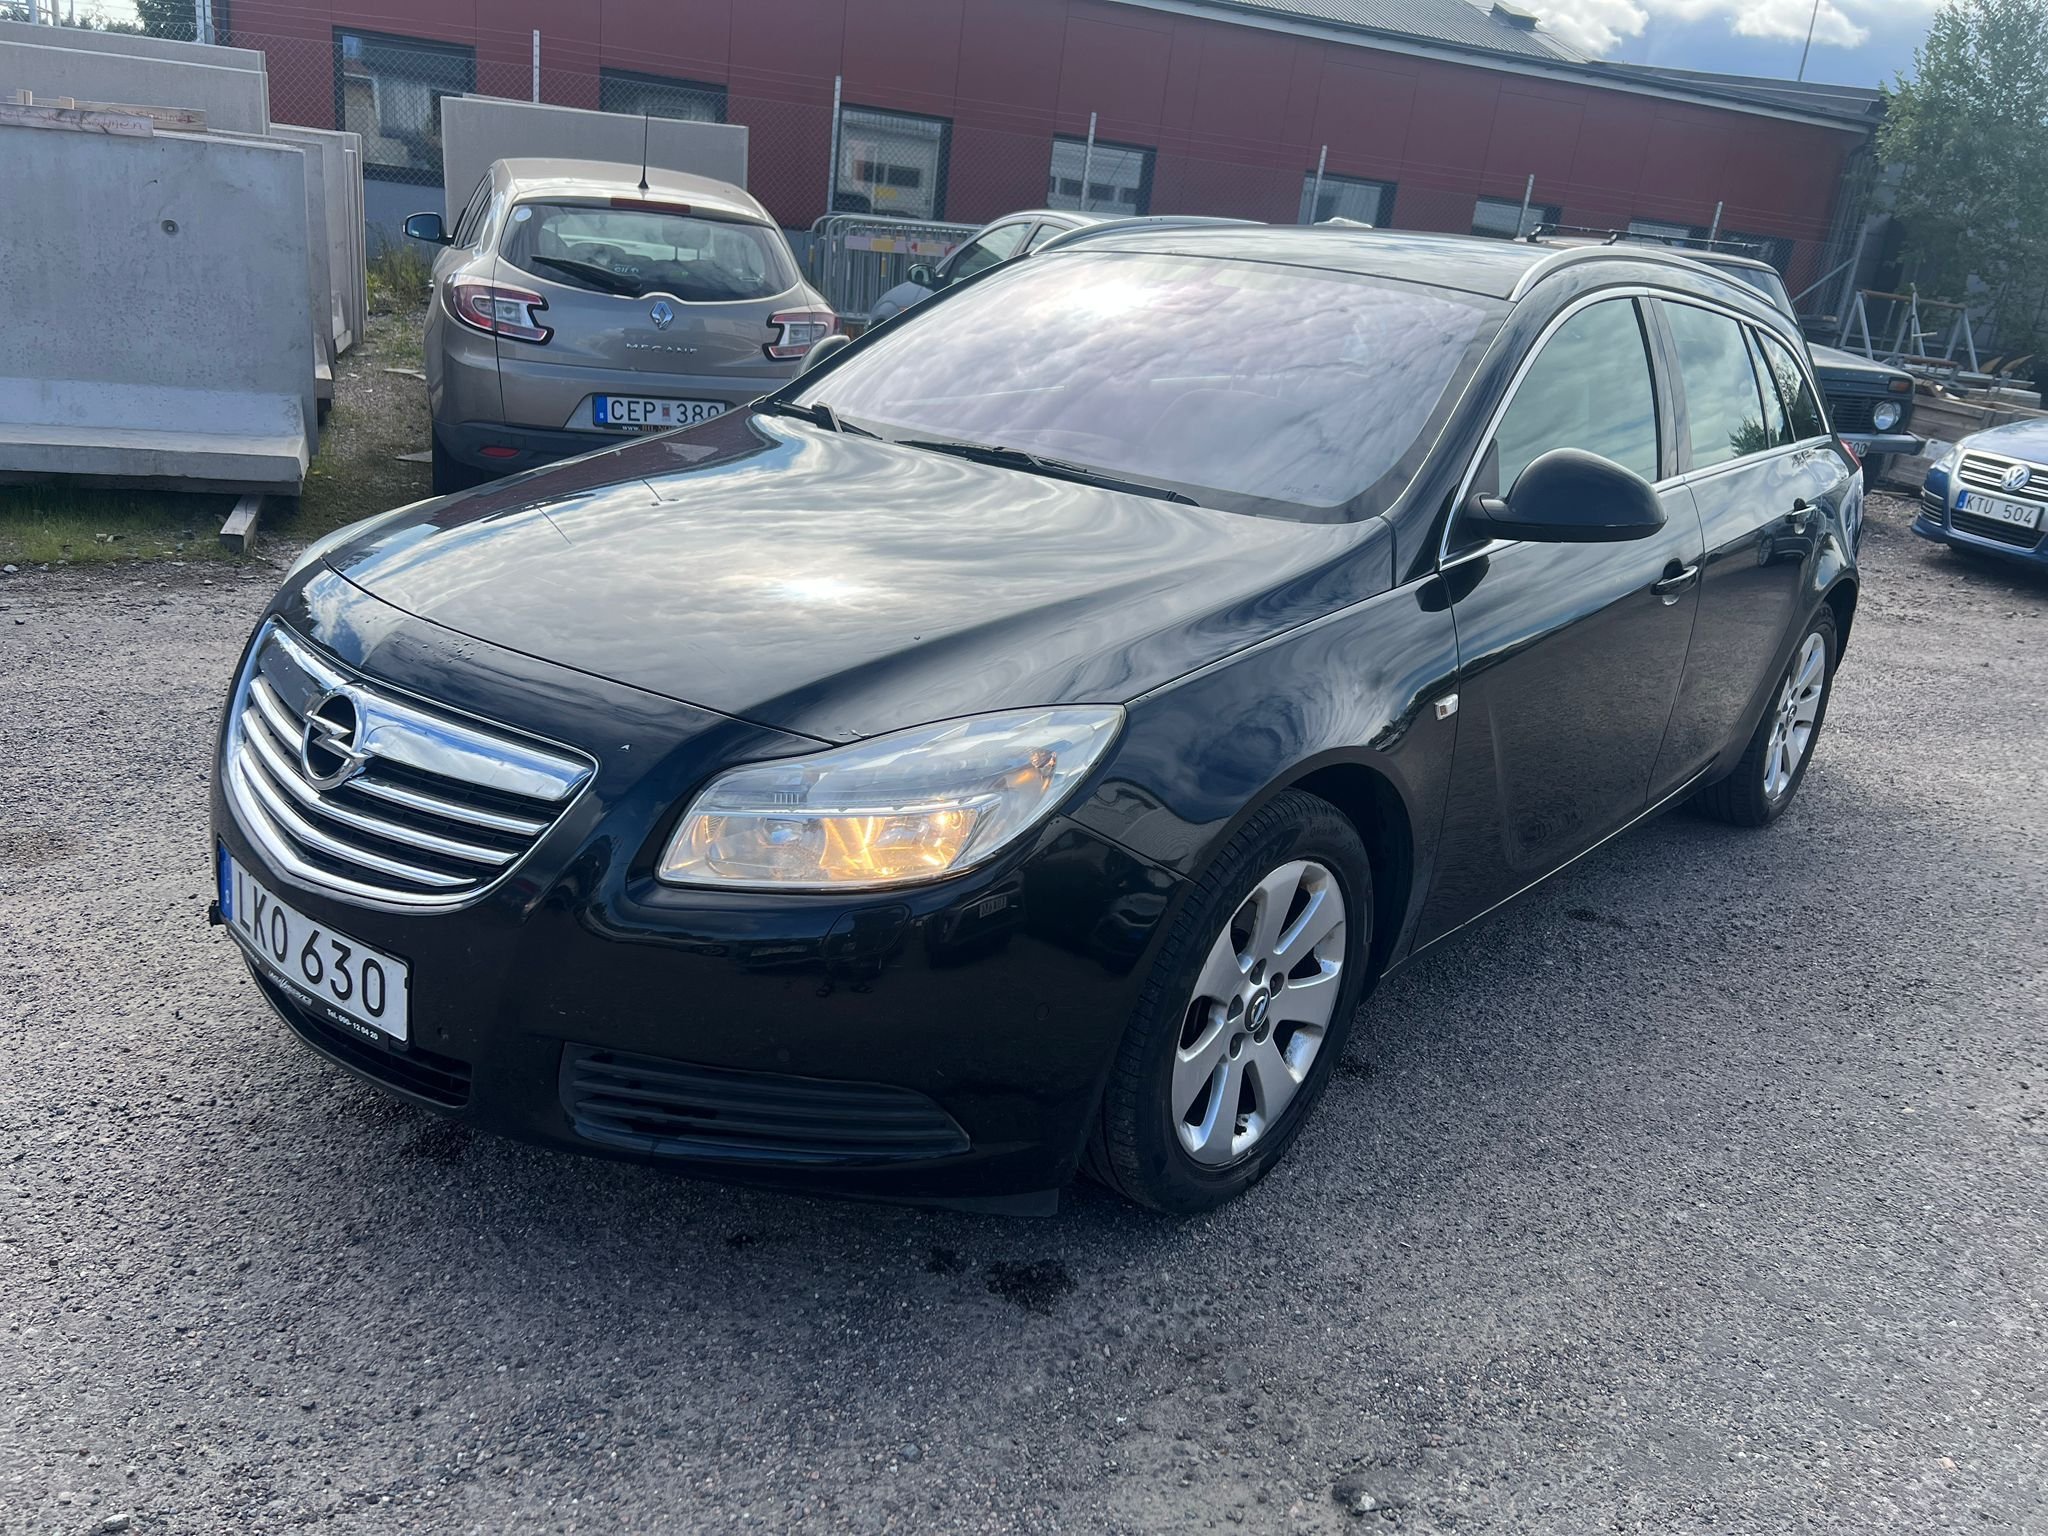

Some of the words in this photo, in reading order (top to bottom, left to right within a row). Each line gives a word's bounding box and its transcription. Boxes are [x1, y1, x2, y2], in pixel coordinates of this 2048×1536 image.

[611, 399, 656, 422] CEP
[1966, 494, 1994, 514] KTU
[2003, 504, 2034, 525] 504
[239, 871, 288, 963] LKO
[301, 929, 386, 1018] 630
